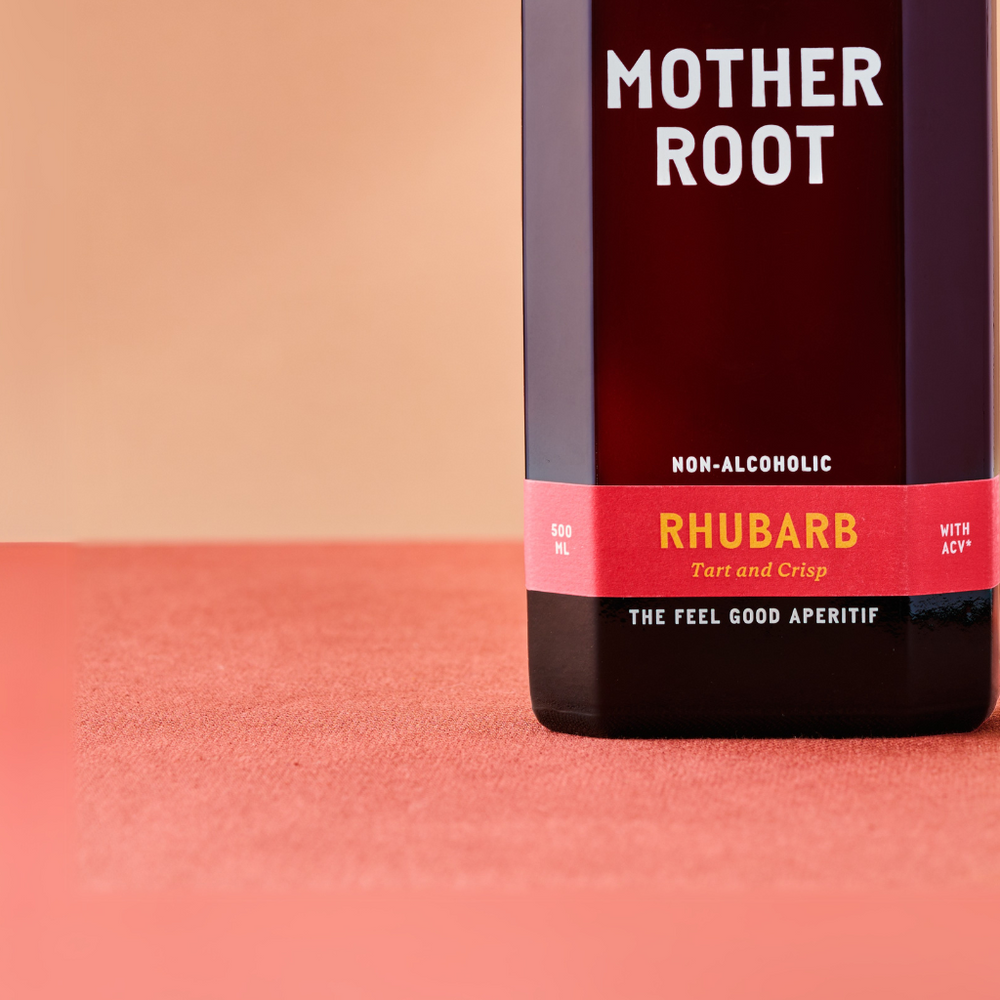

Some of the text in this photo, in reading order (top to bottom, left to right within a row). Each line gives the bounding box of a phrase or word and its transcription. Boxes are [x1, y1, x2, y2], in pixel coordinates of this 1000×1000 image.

[606, 46, 884, 110] MOTHER
[656, 124, 835, 187] ROOT
[672, 455, 833, 474] NON-ALCOHOLIC
[551, 523, 573, 539] 500
[659, 512, 859, 550] RHUBARB
[940, 522, 971, 538] WITH
[555, 540, 570, 556] ML
[690, 561, 828, 582] Tart and Crisp
[628, 607, 879, 626] THE FEEL GOOD APERITIF
